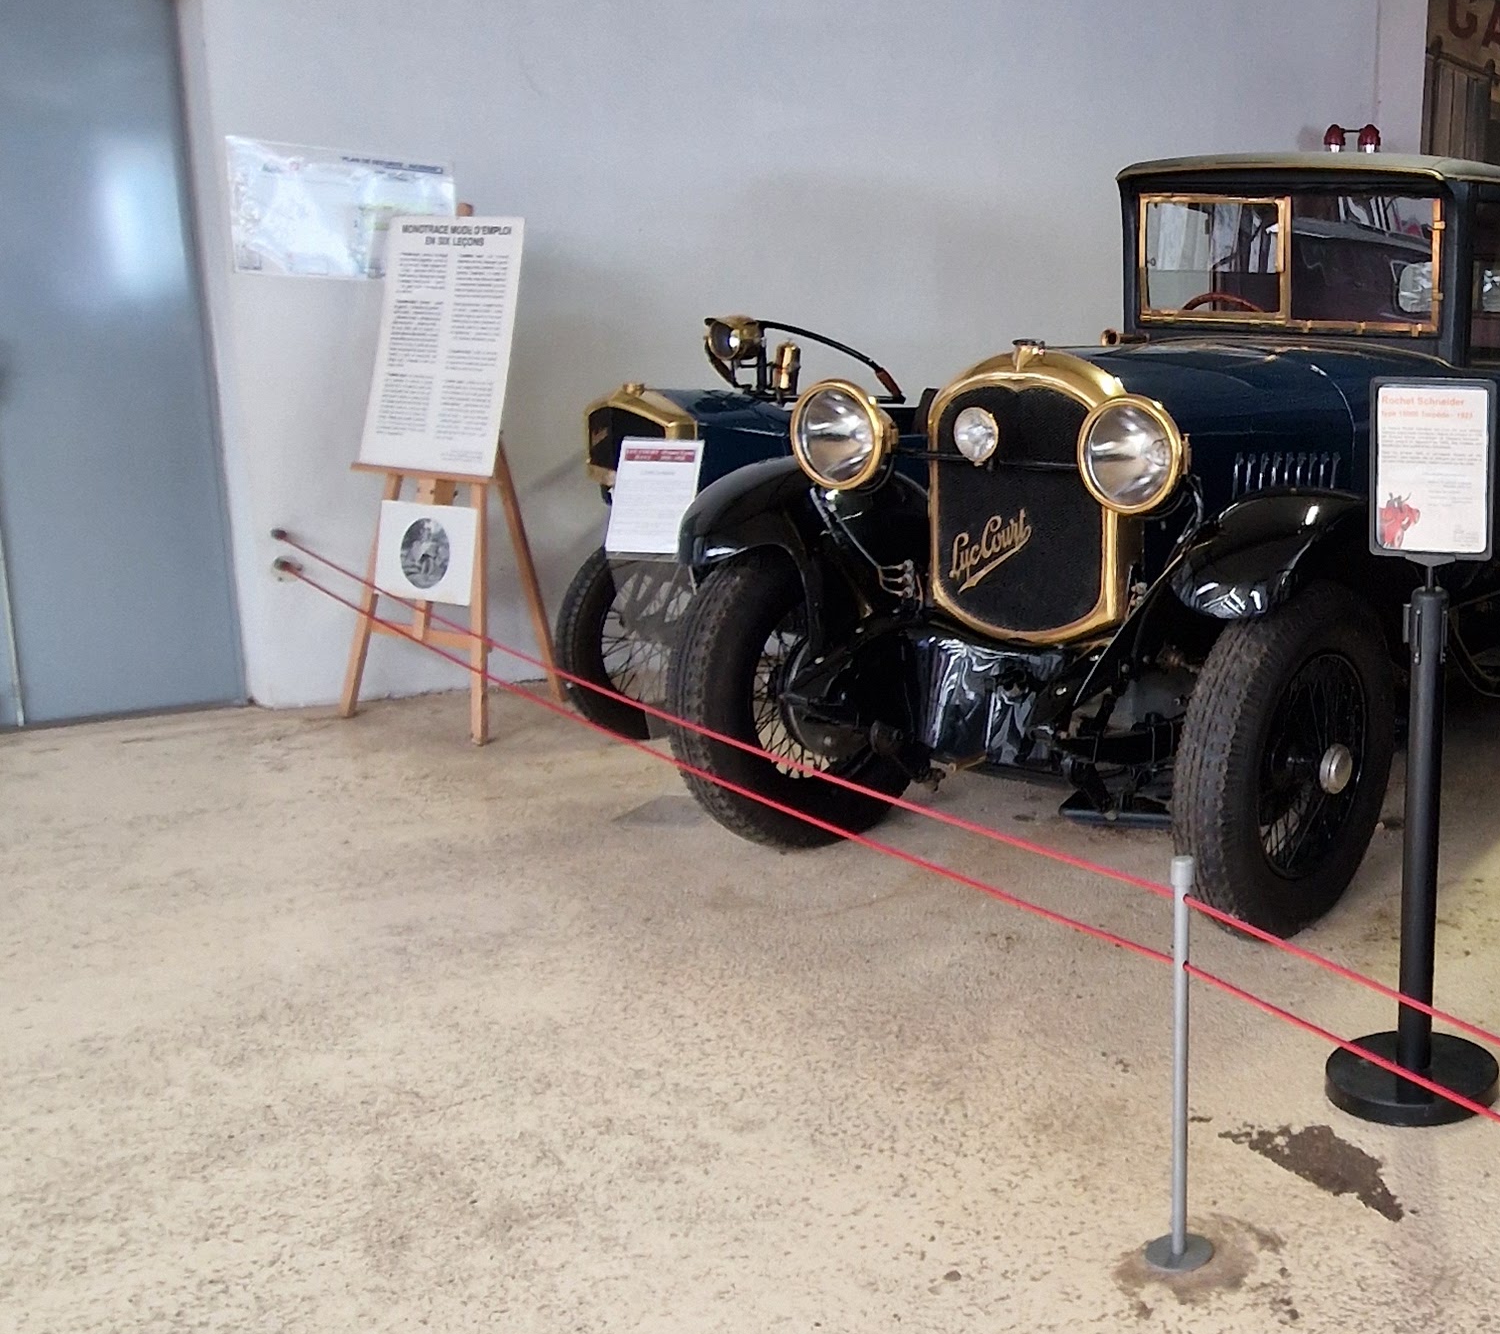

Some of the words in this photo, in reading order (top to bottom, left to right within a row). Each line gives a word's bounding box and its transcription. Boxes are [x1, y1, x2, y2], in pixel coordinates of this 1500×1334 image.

[401, 224, 449, 234] MONOTRACE
[450, 225, 472, 235] MODE
[474, 226, 512, 235] D'EMPLOI
[425, 236, 435, 245] EN
[438, 237, 450, 245] SIX
[452, 237, 484, 247] LEÇONS
[1417, 396, 1465, 407] Schneider
